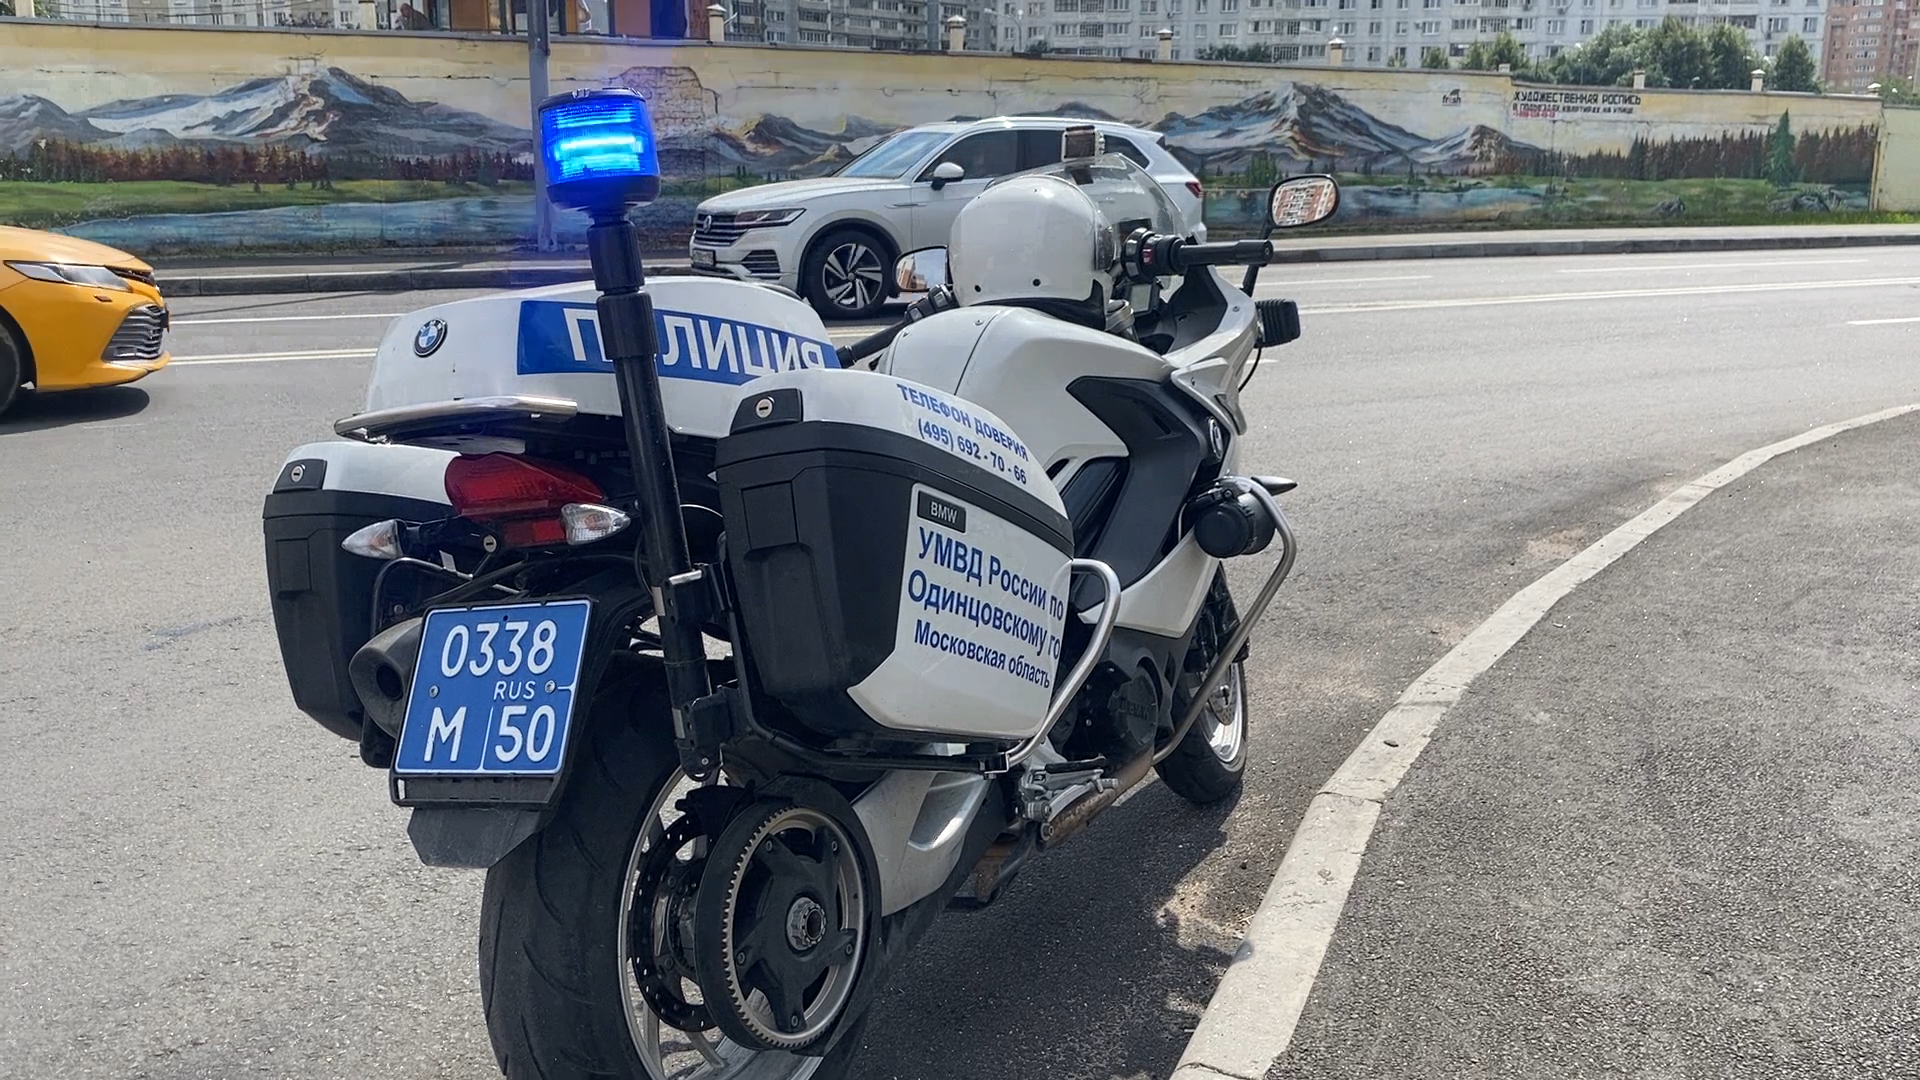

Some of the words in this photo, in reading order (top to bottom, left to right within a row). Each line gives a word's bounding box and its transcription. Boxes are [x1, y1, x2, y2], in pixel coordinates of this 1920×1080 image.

[1514, 91, 1598, 104] ХУДОЖЕСТВЕННАЯ
[1601, 94, 1641, 105] РОСПИСЬ
[562, 307, 825, 376] ПЛИЦИЯ
[896, 383, 972, 429] ТЕЛЕФОН
[974, 417, 1029, 462] ДОВЕРИЯ
[918, 418, 954, 451] (495)
[957, 435, 981, 461] 692
[990, 451, 1005, 473] 70
[1013, 465, 1027, 485] 66
[930, 501, 957, 524] BMW
[919, 526, 983, 587] УМВД
[988, 555, 1047, 611] России
[1049, 593, 1064, 621] по
[908, 569, 1047, 657] Одинцовскому
[441, 620, 557, 677] 0338
[914, 618, 1005, 671] Московская
[1008, 655, 1051, 689] область
[493, 680, 536, 700] RUS
[423, 706, 467, 762] М
[494, 705, 556, 762] 50
